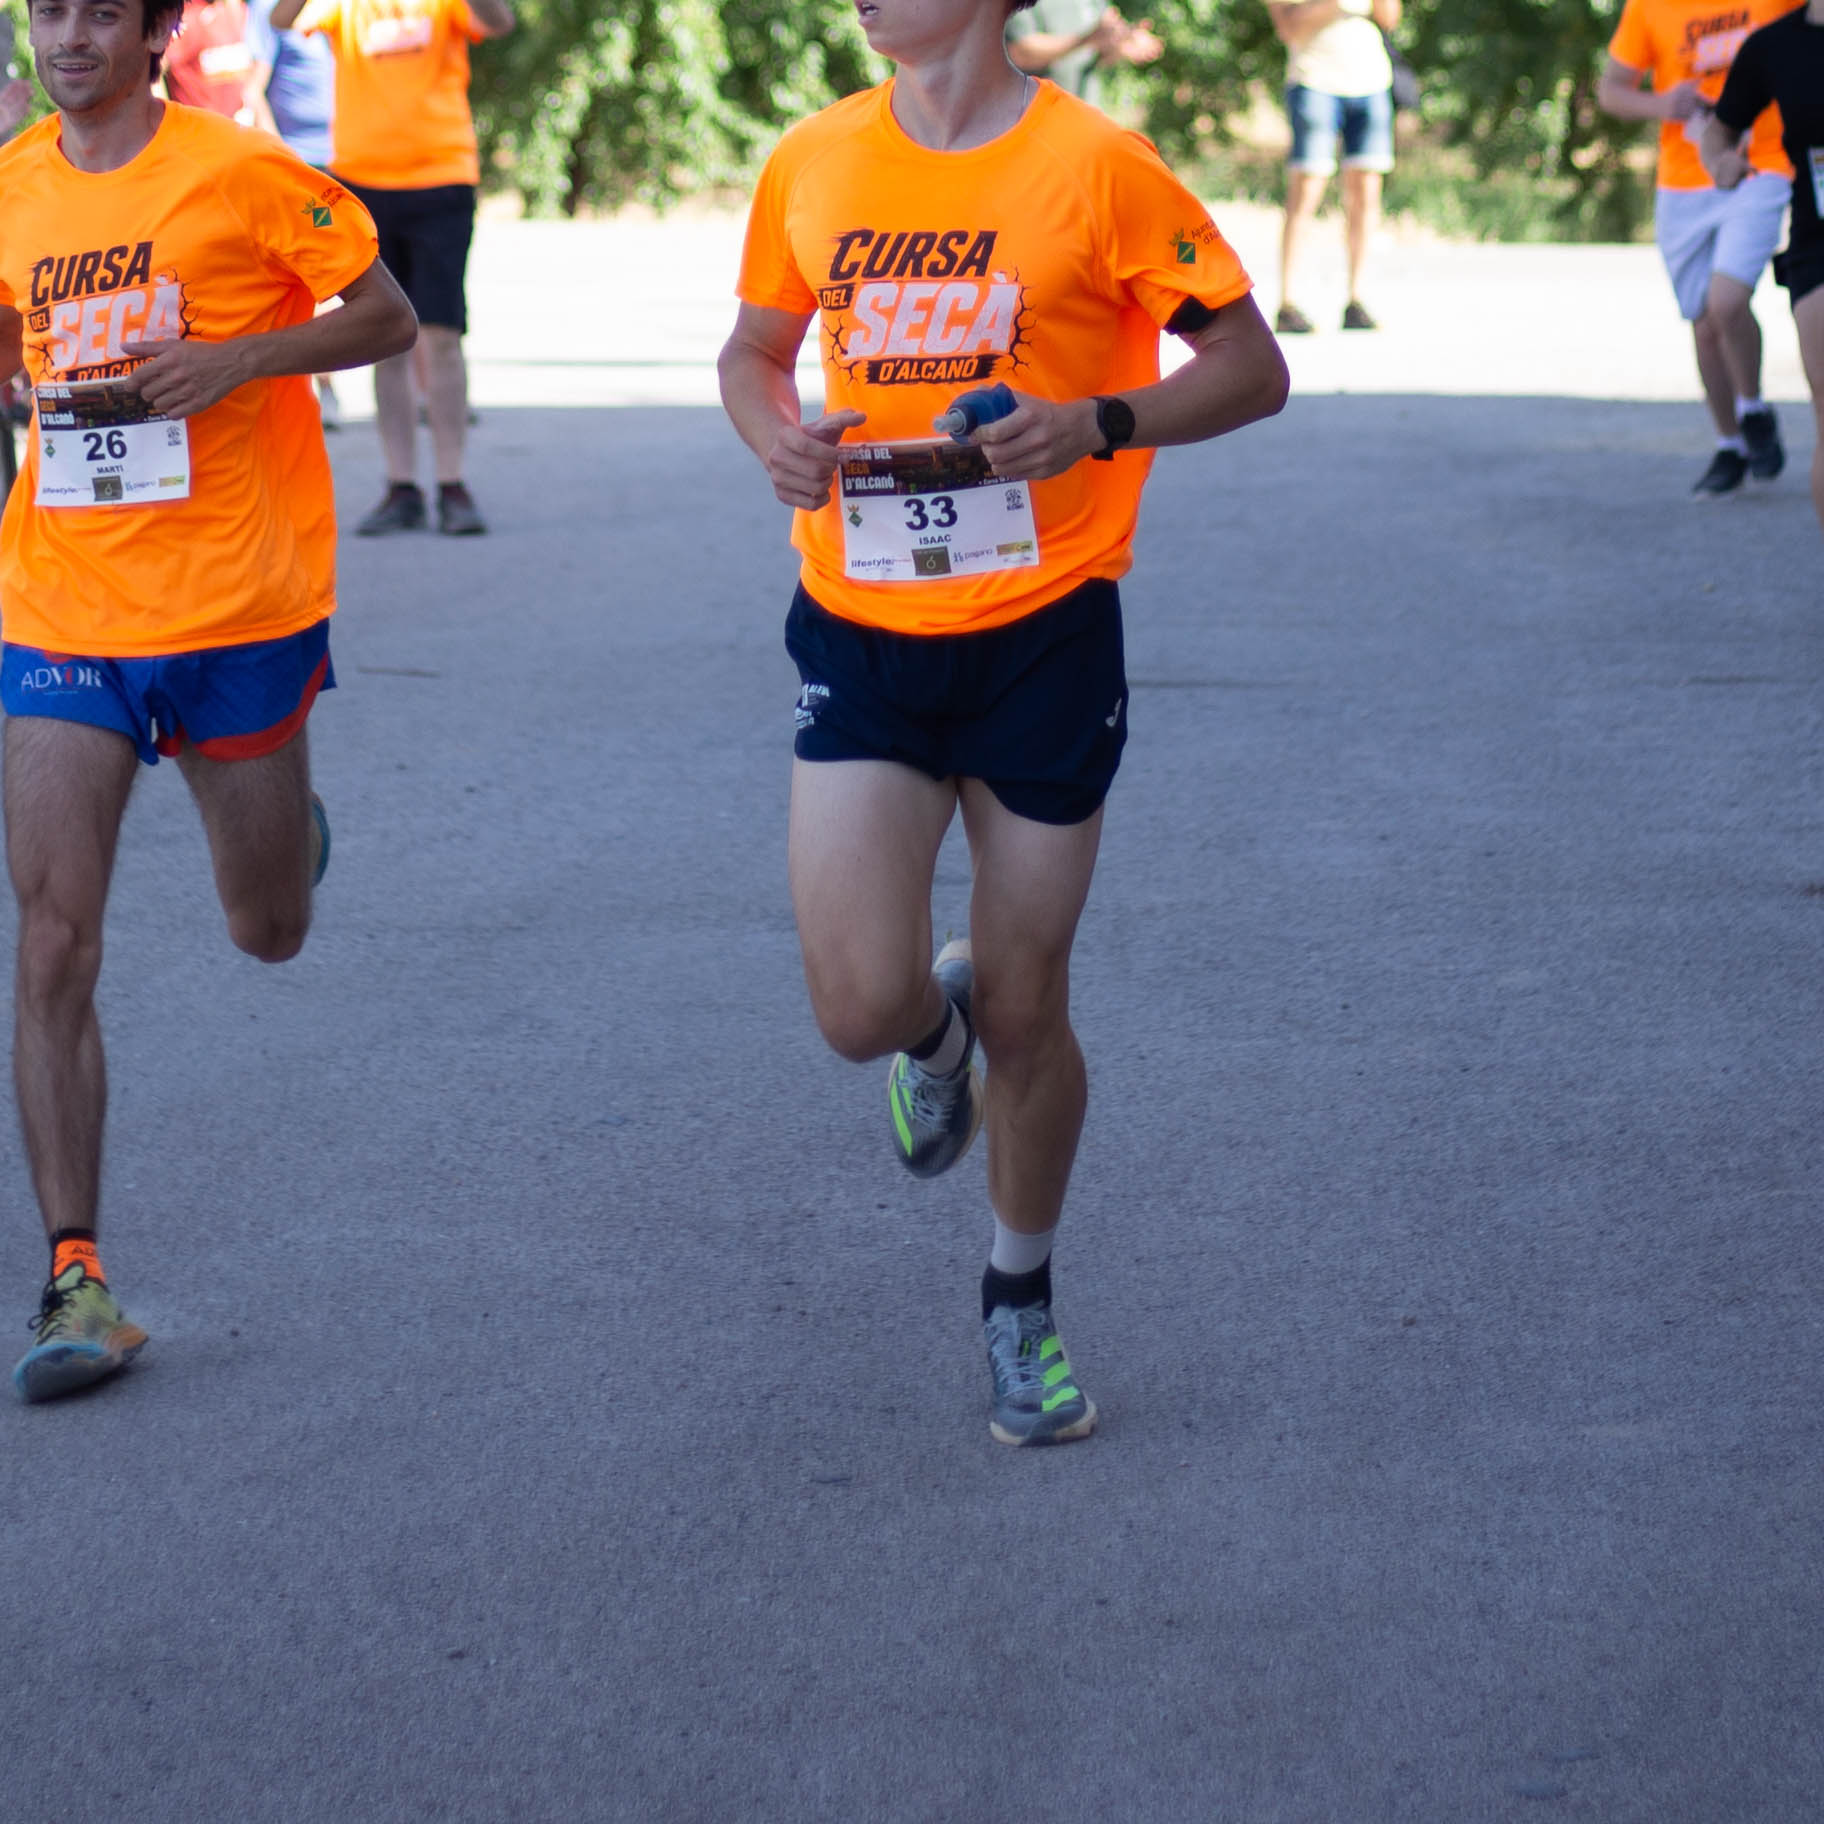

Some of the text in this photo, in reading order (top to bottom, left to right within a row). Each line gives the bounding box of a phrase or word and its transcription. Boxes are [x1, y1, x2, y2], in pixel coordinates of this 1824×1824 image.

[31, 241, 153, 307] CURSA
[828, 228, 998, 281] CURSA
[30, 275, 180, 371] DEL SECÀ
[822, 272, 1018, 360] DEL SECÀ
[83, 430, 127, 461] 26
[904, 495, 958, 531] 33
[919, 534, 952, 545] ISAAC
